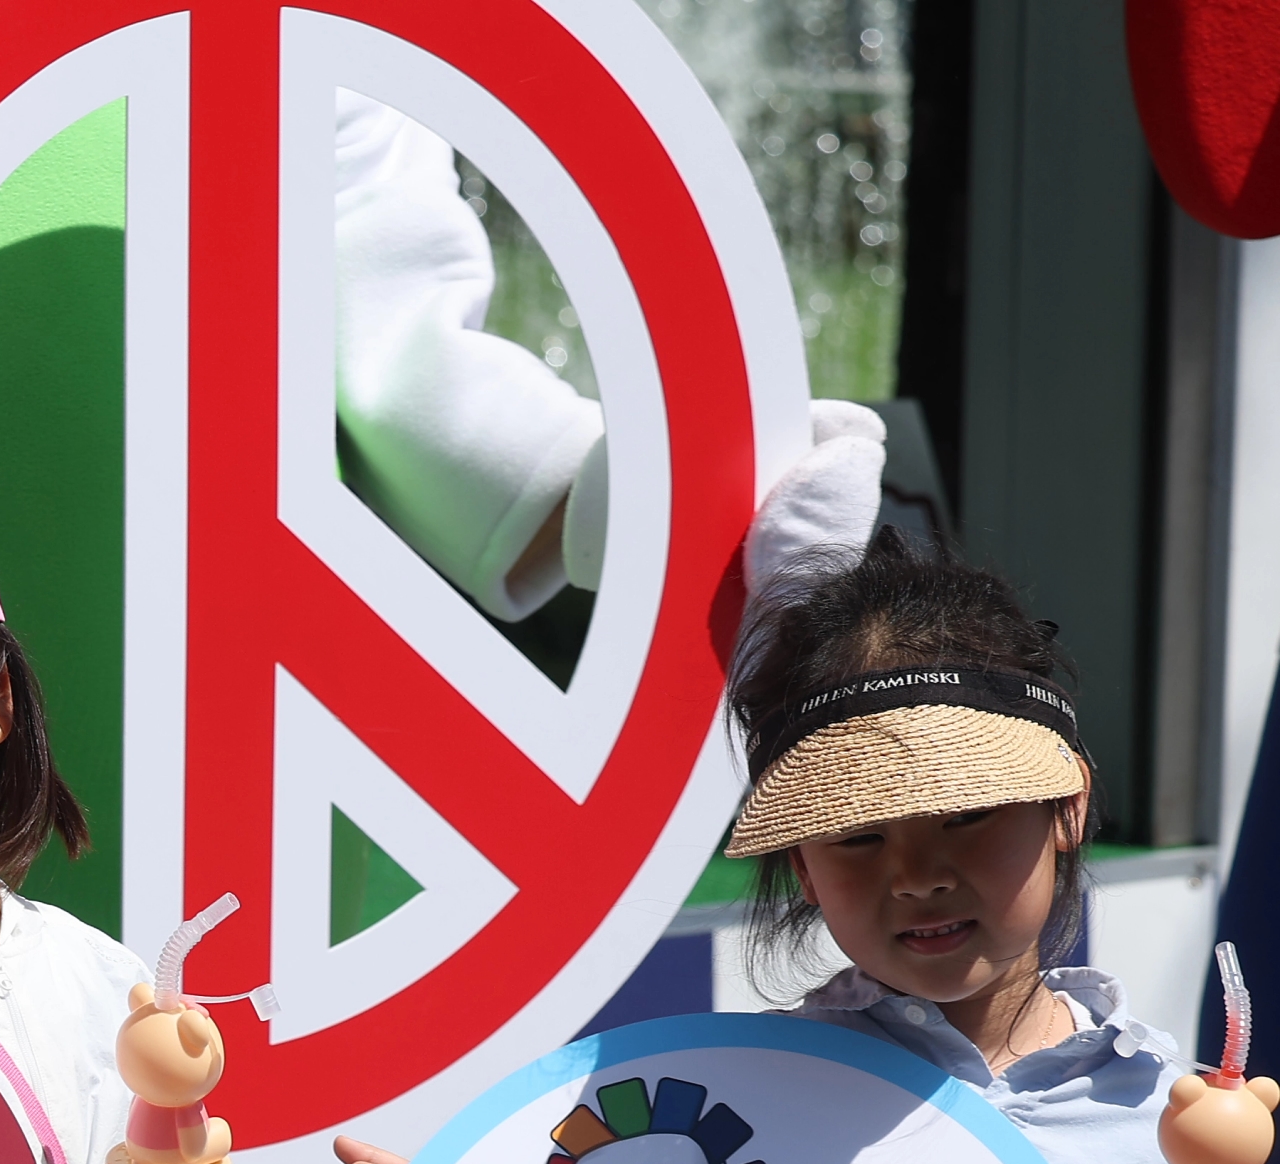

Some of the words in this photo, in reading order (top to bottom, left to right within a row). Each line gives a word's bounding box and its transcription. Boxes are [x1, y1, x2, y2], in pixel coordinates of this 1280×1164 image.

[801, 684, 858, 714] HELEN
[862, 672, 961, 693] KAMINSKI
[1025, 683, 1060, 709] HELEN
